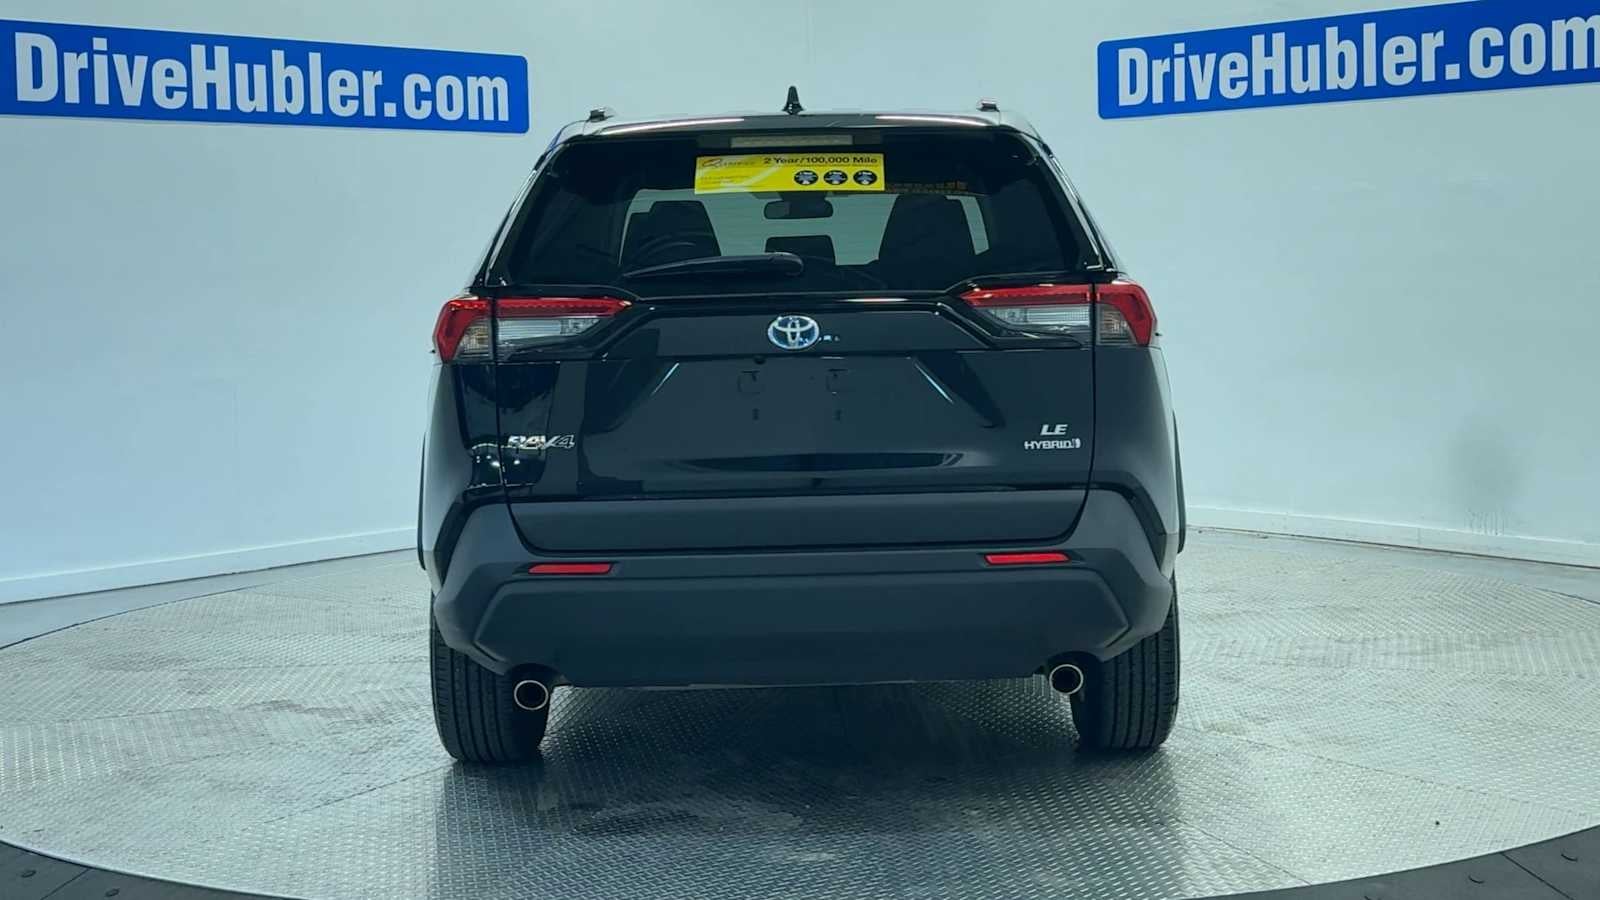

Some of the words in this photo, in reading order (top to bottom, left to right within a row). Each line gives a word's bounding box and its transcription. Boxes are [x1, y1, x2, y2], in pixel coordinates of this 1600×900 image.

[1118, 14, 1600, 107] DriveHubler.com
[14, 31, 510, 122] DriveHubler.com
[763, 157, 771, 165] 2
[774, 156, 850, 165] Year/100,000
[1040, 423, 1068, 436] LE
[507, 434, 575, 450] RAV4
[1024, 440, 1073, 450] HYBRID
